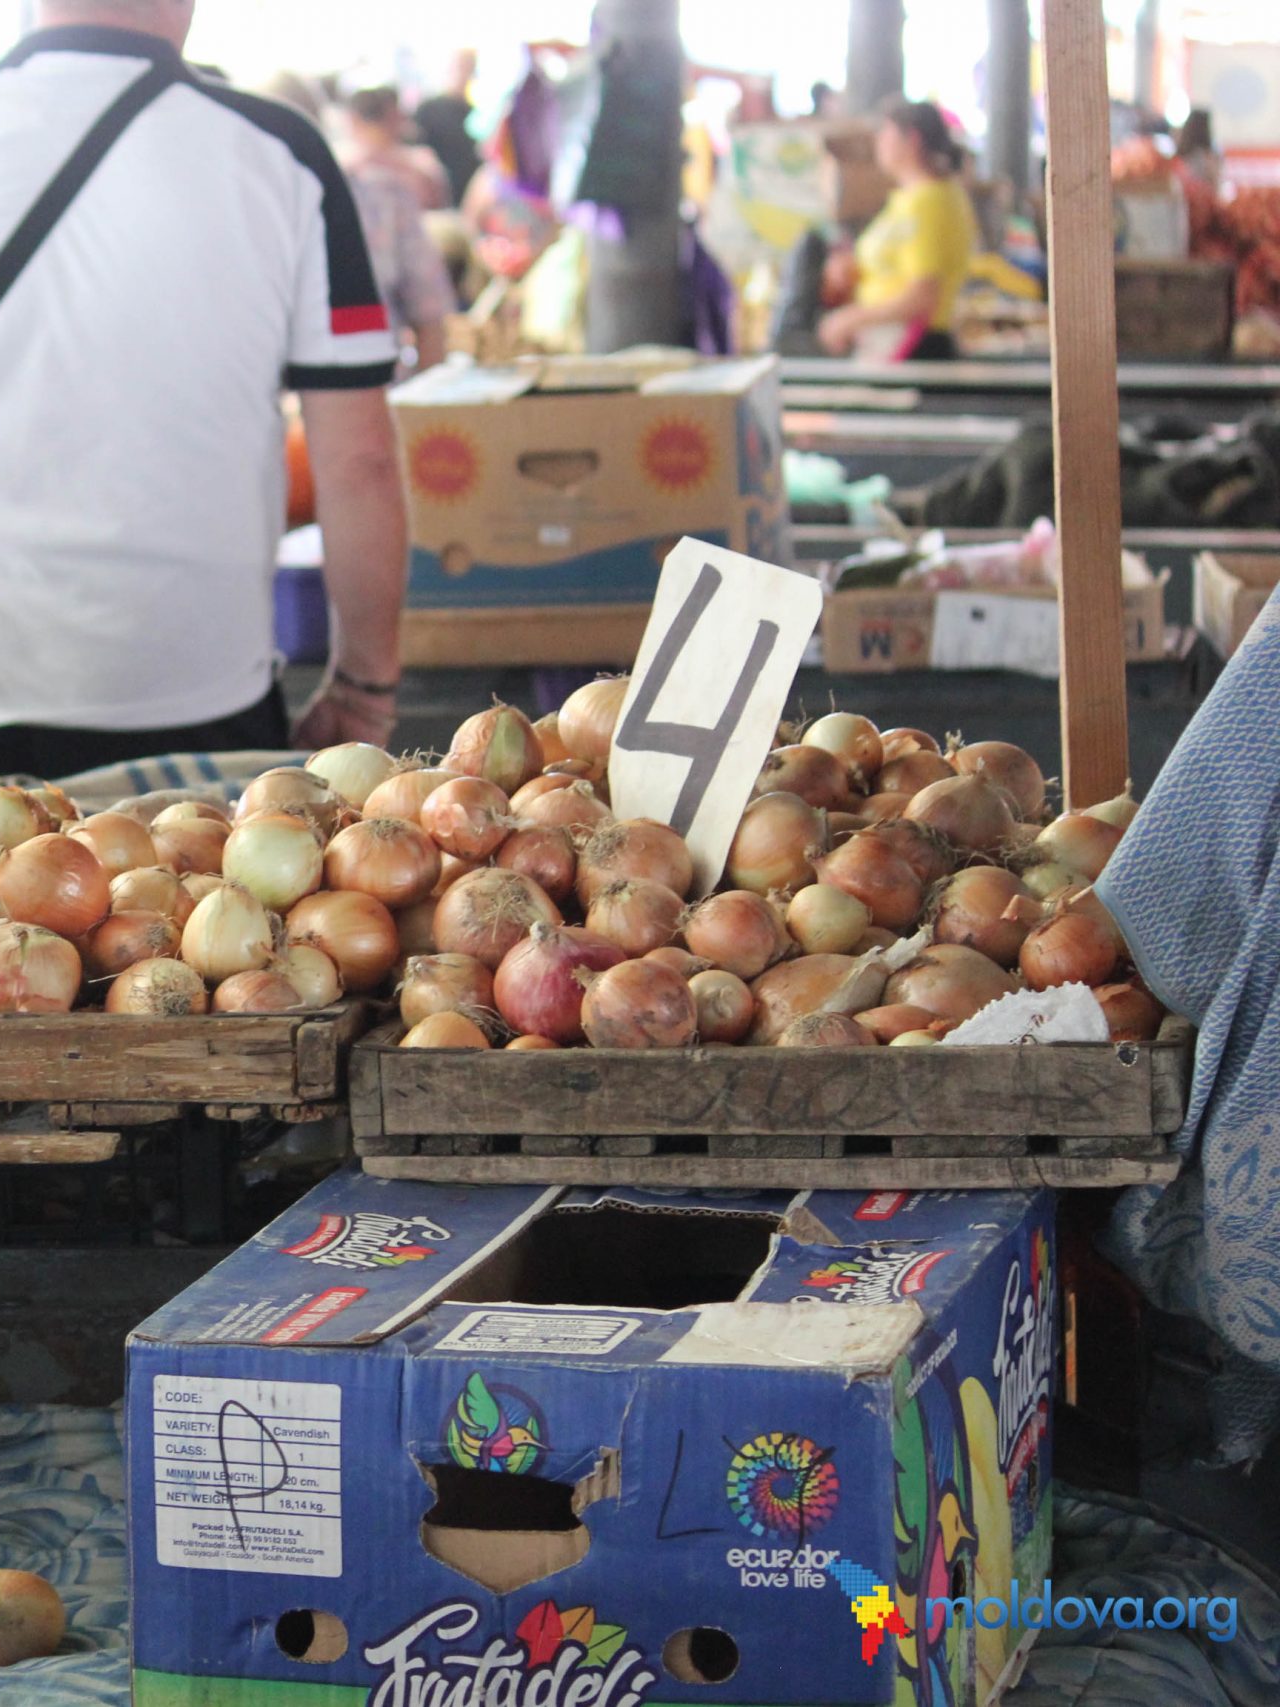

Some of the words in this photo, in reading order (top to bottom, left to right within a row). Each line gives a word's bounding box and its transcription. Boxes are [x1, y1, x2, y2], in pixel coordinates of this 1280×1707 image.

[615, 562, 780, 838] 4
[312, 1212, 451, 1269] Frutadeli
[165, 1391, 202, 1404] CODE:
[165, 1420, 216, 1433] VARIETY:
[273, 1426, 331, 1440] Cavendish
[165, 1443, 207, 1457] CLASS:
[299, 1452, 305, 1462] 1
[166, 1468, 211, 1481] MINIMUM
[213, 1471, 259, 1483] LENGTH:
[300, 1478, 320, 1488] cm.
[167, 1491, 188, 1503] NET
[279, 1499, 308, 1511] 18,14
[309, 1500, 327, 1513] kg.
[192, 1523, 224, 1532] Packed
[239, 1526, 286, 1536] FRUTADELI
[288, 1528, 304, 1537] S.A.
[726, 1544, 841, 1569] ecuador
[740, 1567, 790, 1589] love
[793, 1567, 827, 1589] life
